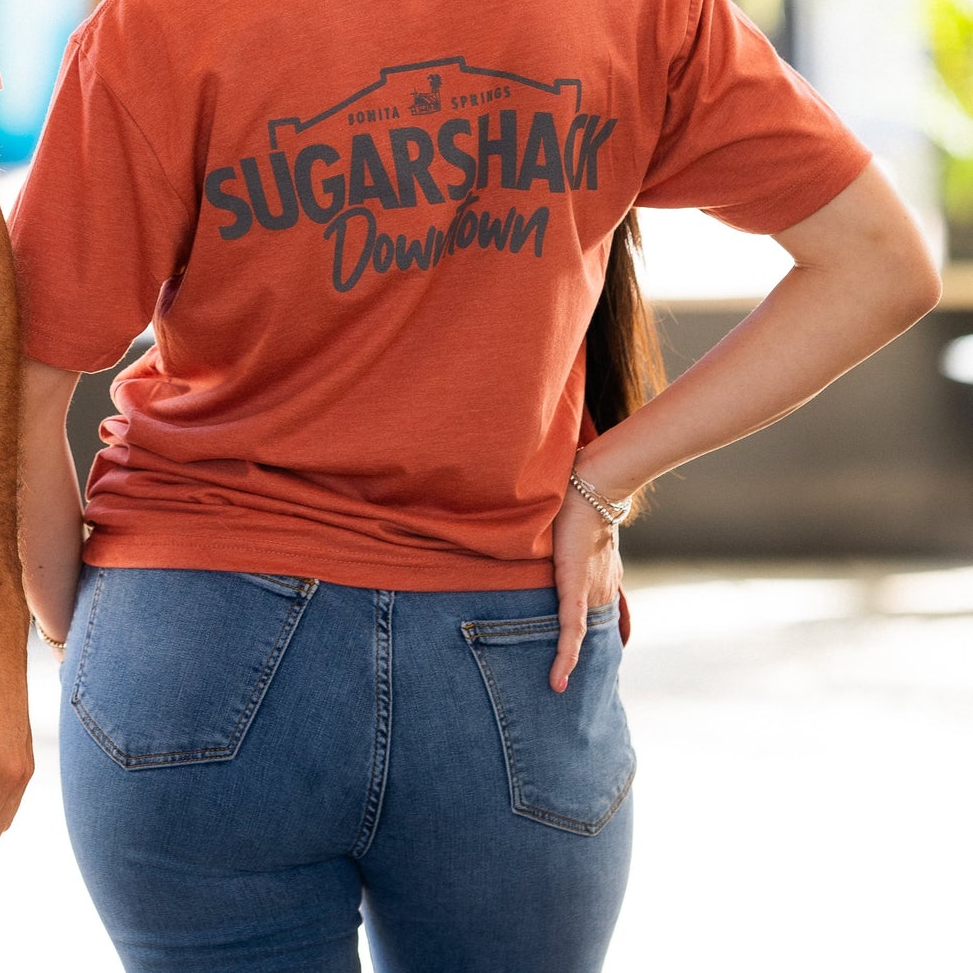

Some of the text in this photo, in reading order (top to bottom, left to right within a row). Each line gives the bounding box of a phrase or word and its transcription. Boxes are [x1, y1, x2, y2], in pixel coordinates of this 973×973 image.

[347, 85, 512, 126] BONITA SPRINGS
[205, 109, 618, 240] SUGARSHACK
[323, 191, 550, 293] Downtown
